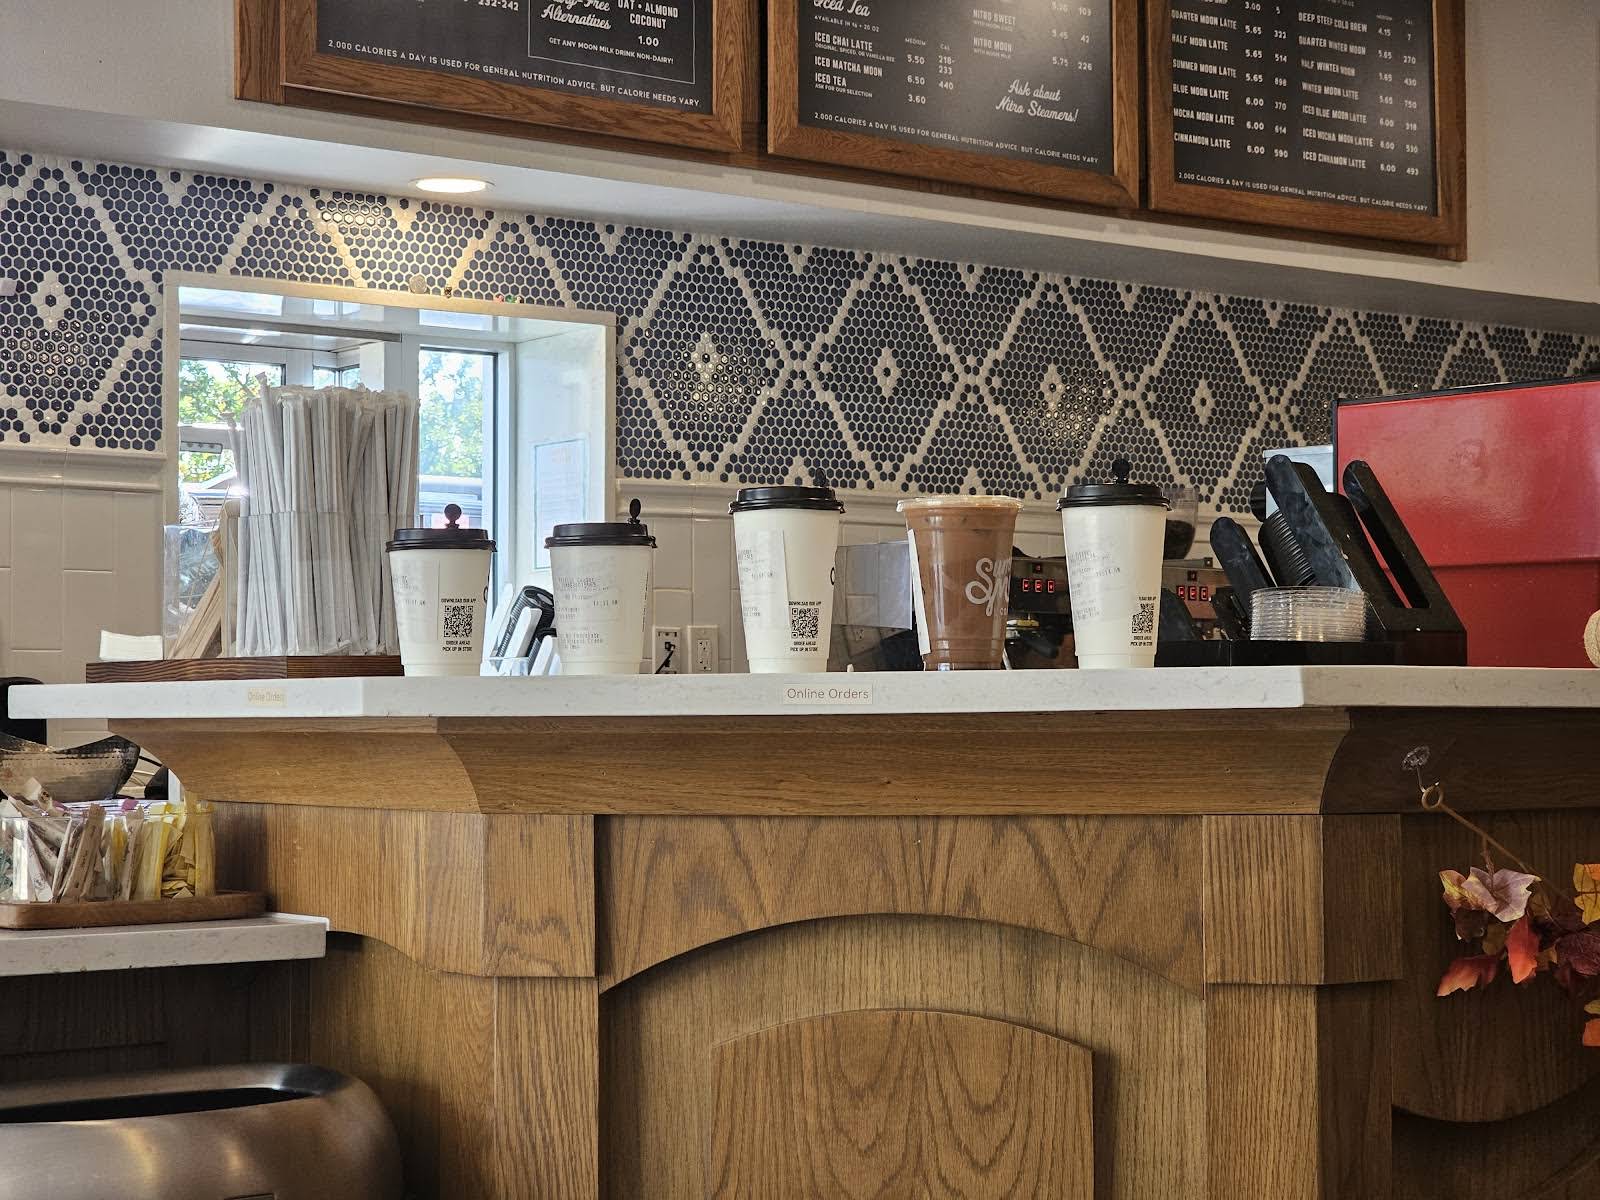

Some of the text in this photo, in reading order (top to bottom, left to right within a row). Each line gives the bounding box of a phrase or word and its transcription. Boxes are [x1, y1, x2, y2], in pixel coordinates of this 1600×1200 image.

[645, 2, 679, 18] ALMOND
[847, 0, 871, 17] Tea
[1244, 1, 1261, 12] 3.00
[541, 3, 612, 30] Alternatives
[629, 13, 667, 30] COCONUT
[973, 9, 1016, 25] NITRO SWEET
[1171, 9, 1237, 30] QUARTER MOON LATTE
[1298, 12, 1368, 33] DEEP STEEP COLD BREW
[1244, 24, 1262, 35] 5.65
[637, 35, 660, 47] 1.00
[814, 31, 873, 52] ICED CHAI LATTE
[973, 36, 992, 49] NITRO
[993, 39, 1012, 53] MOON
[1171, 33, 1229, 51] HALF MOON LATTE
[1298, 35, 1327, 48] QUARTER
[1349, 44, 1367, 56] MOON
[549, 37, 675, 65] GET ANY MOON MILK DRINK NON-DAIRY!
[907, 54, 925, 65] 5.50
[1245, 48, 1263, 59] 5.65
[354, 44, 398, 58] CALORIES
[408, 52, 427, 63] DAY
[429, 56, 437, 64] IS
[440, 57, 462, 69] USED
[464, 61, 480, 72] FOR
[482, 65, 520, 79] GENERAL
[522, 71, 565, 86] NUTRITION
[600, 83, 616, 94] BUT
[617, 87, 650, 100] CALORIE
[652, 93, 677, 104] NEEDS
[814, 55, 883, 77] ICED MATCHA MOON
[1172, 58, 1237, 79] SUMMER MOON LATTE
[1300, 58, 1315, 70] HALF
[1316, 61, 1339, 74] WINTER
[815, 72, 847, 87] ICED TEA
[907, 74, 925, 85] 6.50
[938, 81, 954, 90] 440
[1245, 73, 1263, 83] 5.65
[846, 88, 873, 98] SELECTION
[907, 93, 926, 104] 3.60
[1008, 79, 1061, 102] Ask about
[1172, 83, 1230, 101] BLUE MOON LATTE
[1323, 85, 1342, 97] MOON
[1342, 89, 1360, 101] LATTE
[995, 95, 1079, 122] Nitro Steamers!
[1245, 96, 1265, 107] 6.00
[1173, 107, 1235, 126] MOCHA MOON LATTE
[1302, 104, 1368, 124] ICED BLUE MOON LATTE
[1246, 120, 1265, 131] 6.00
[834, 115, 867, 128] CALORIES
[875, 121, 889, 130] DAY
[890, 124, 897, 132] IS
[898, 126, 915, 135] USED
[916, 128, 930, 137] FOR
[931, 130, 960, 142] GENERAL
[960, 136, 993, 148] NUTRITION
[1020, 145, 1034, 154] BUT
[1035, 148, 1061, 159] CALORIE
[1062, 152, 1081, 161] NEEDS
[1082, 155, 1099, 164] VARY
[1210, 137, 1231, 149] LATTE
[1302, 127, 1317, 138] ICED
[1354, 136, 1374, 148] LATTE
[1246, 145, 1265, 155] 6.00
[1302, 151, 1366, 169] ICED LATTE
[1196, 174, 1224, 185] CALORIES
[1231, 179, 1244, 187] DAY
[1252, 182, 1268, 190] USED
[1280, 186, 1305, 196] GENERAL
[1359, 196, 1371, 204] BUT
[787, 688, 869, 699] Online Orders
